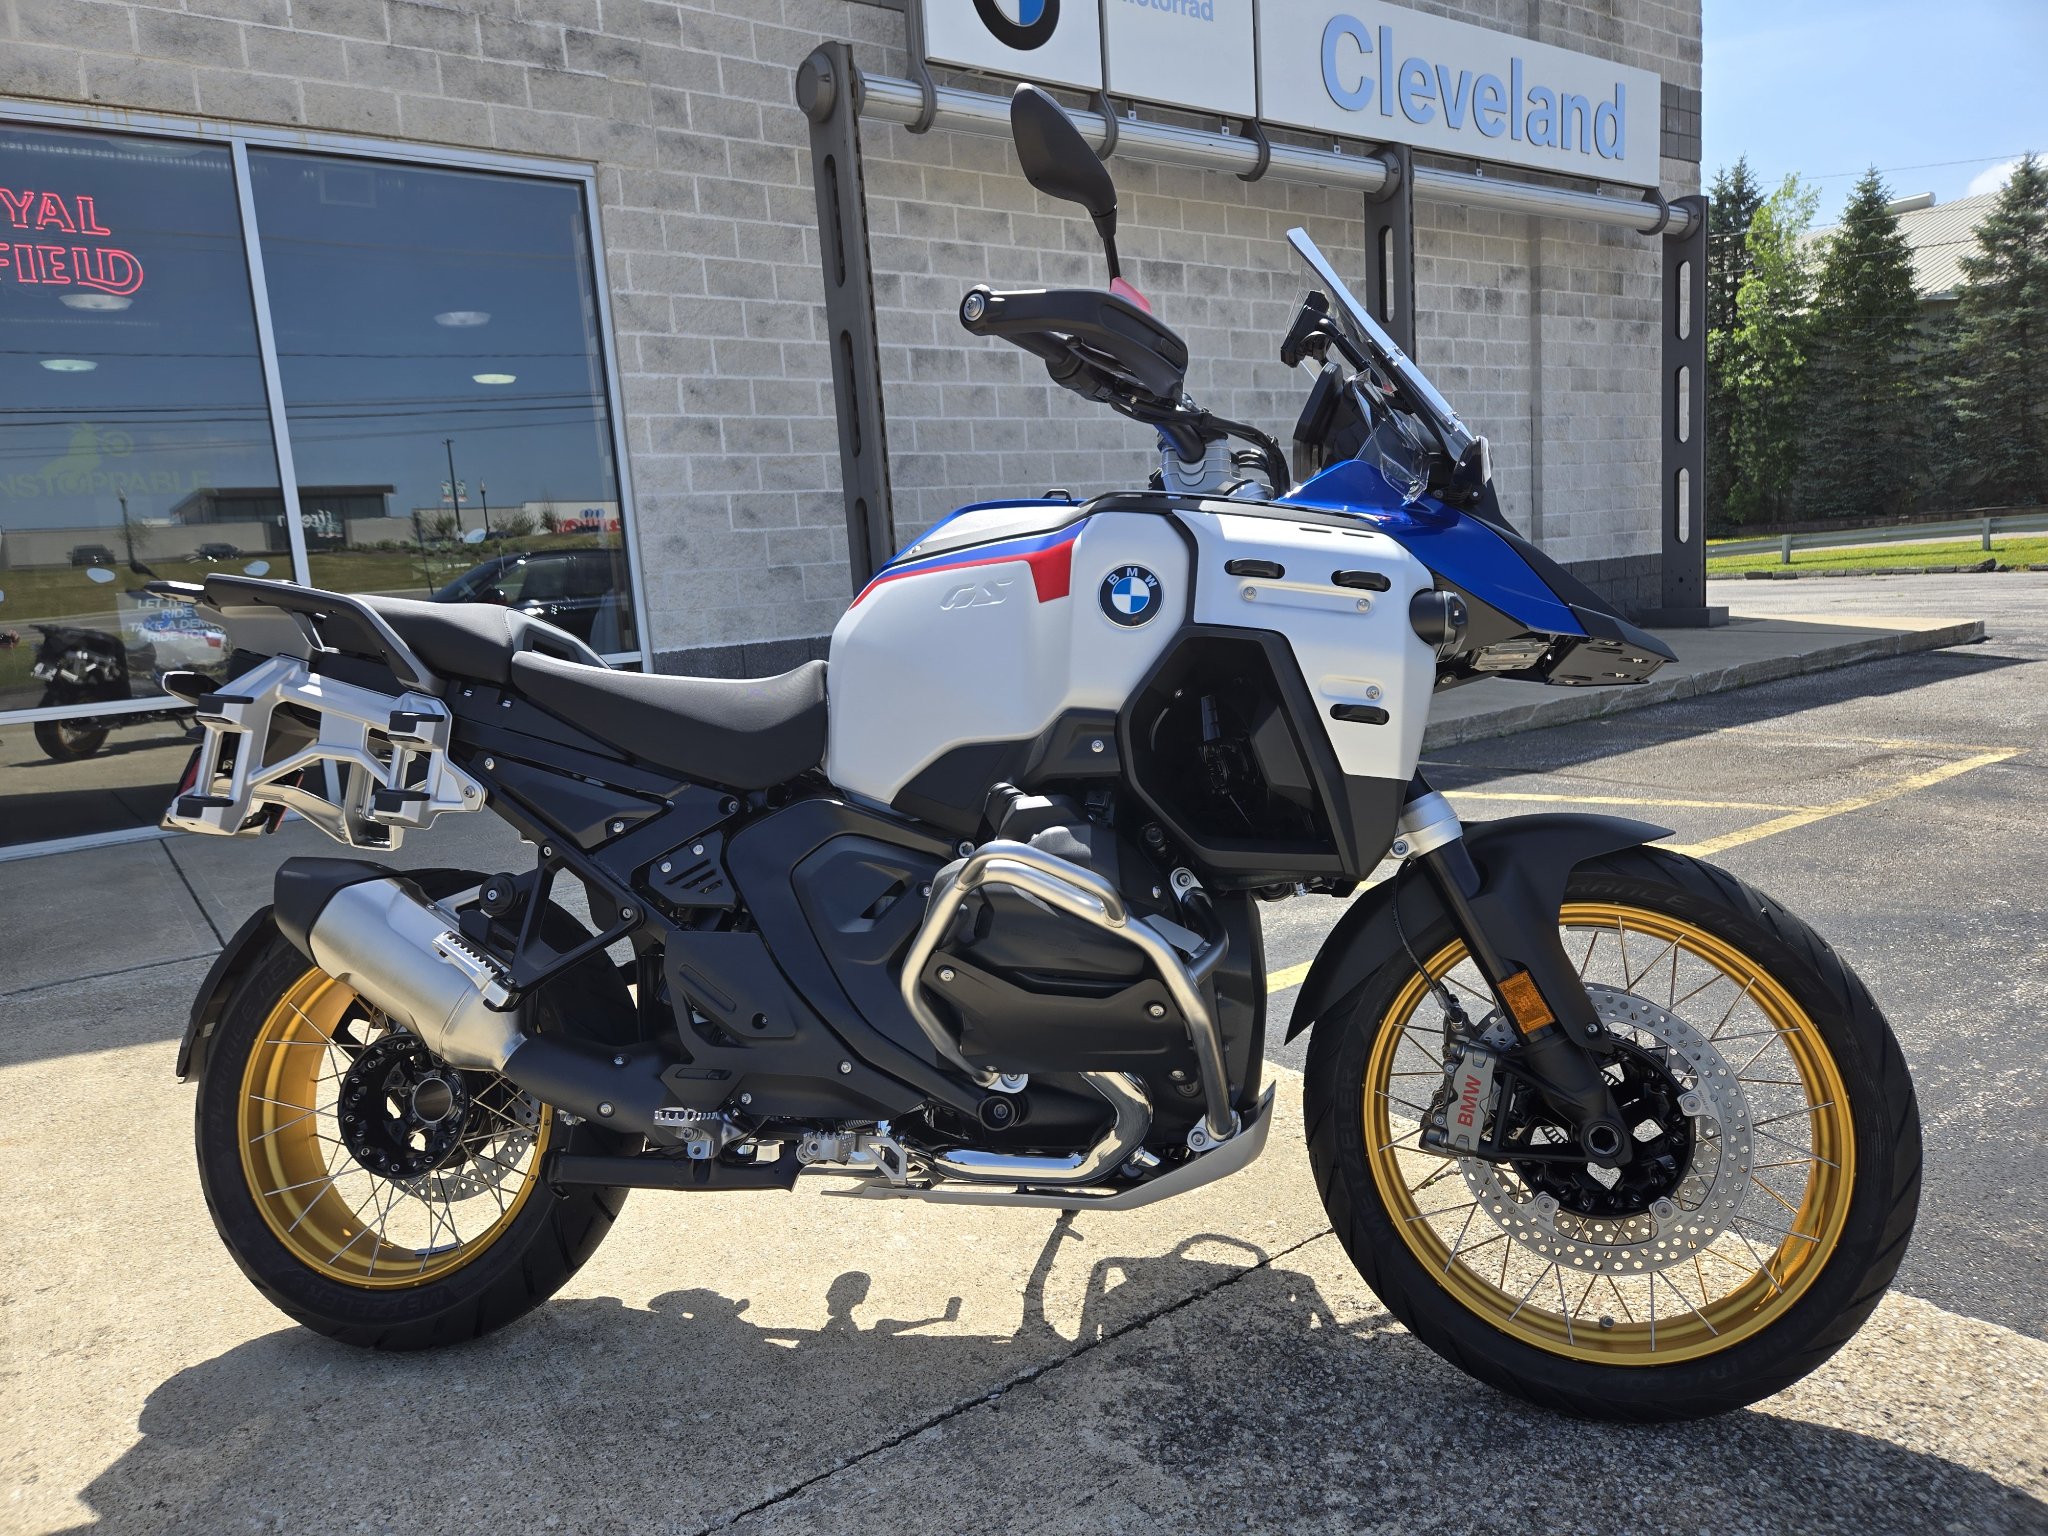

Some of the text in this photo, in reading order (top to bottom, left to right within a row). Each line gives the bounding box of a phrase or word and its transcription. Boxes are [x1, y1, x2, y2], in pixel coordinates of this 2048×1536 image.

[1320, 13, 1626, 160] Cleveland
[1106, 566, 1159, 588] BMW
[1457, 1074, 1482, 1127] BMW
